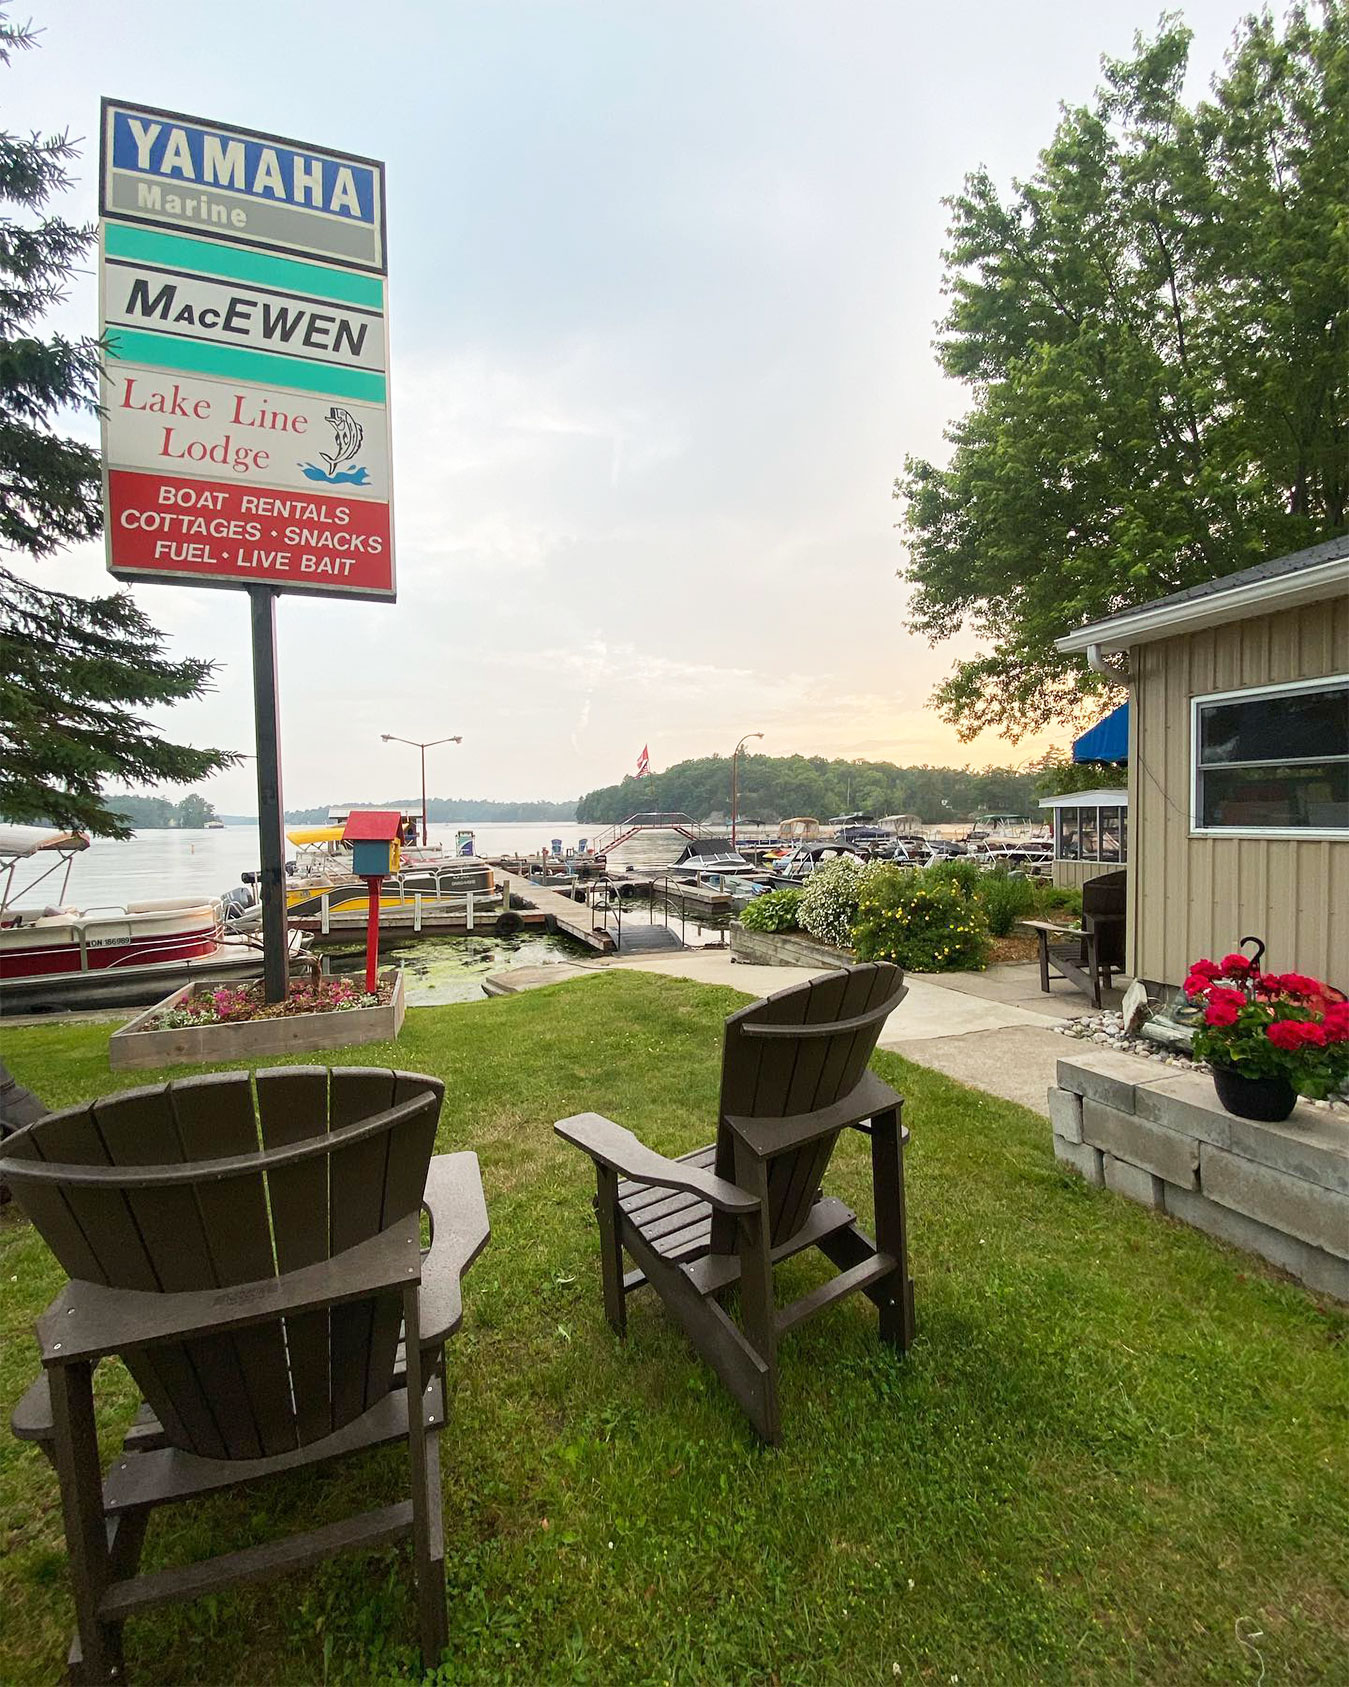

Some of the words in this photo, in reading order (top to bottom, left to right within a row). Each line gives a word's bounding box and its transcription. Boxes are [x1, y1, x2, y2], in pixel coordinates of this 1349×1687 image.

[127, 118, 362, 218] YAMAHA
[137, 182, 248, 228] Marine
[120, 377, 211, 420] Lake
[229, 394, 309, 434] Line
[159, 426, 270, 473] Lodge
[158, 485, 229, 511] BOAT
[240, 495, 350, 525] RENTALS
[120, 509, 262, 541] COTTAGES
[284, 525, 383, 554] SNACKS
[154, 540, 217, 564] FUEL
[237, 548, 292, 571] LIVE
[300, 555, 356, 577] BAIT
